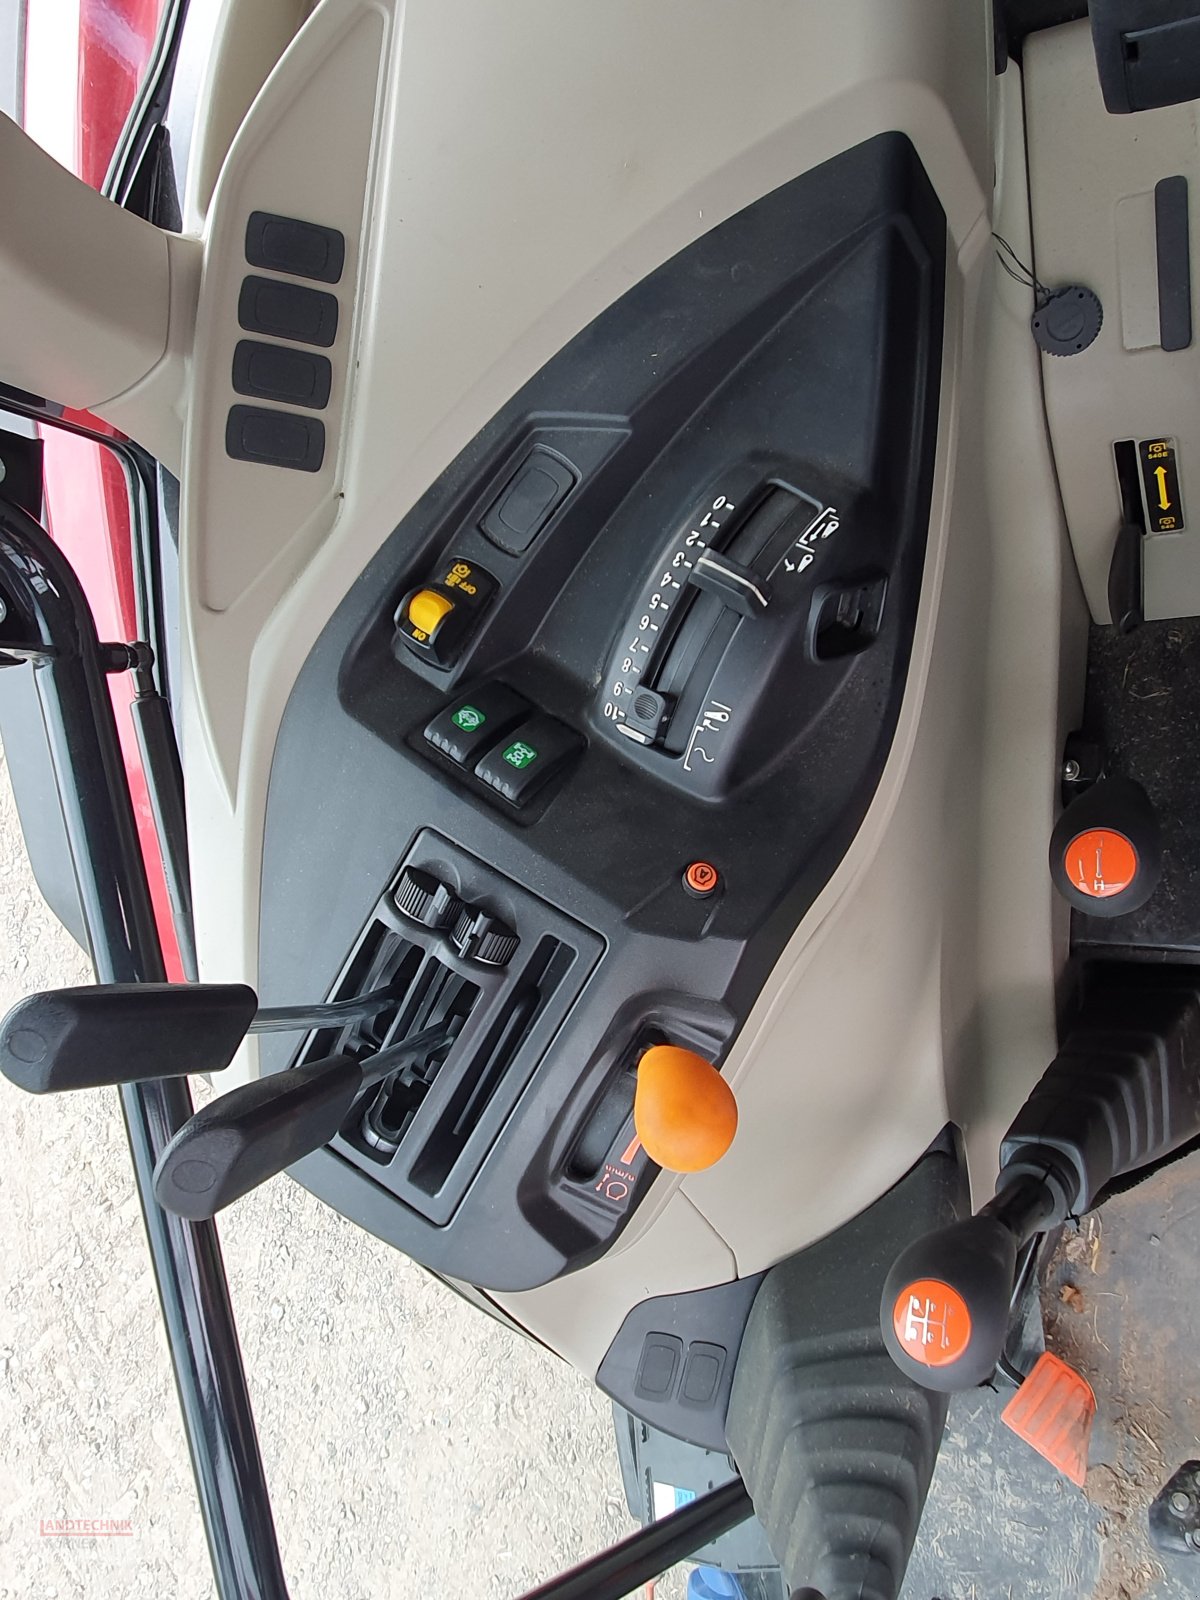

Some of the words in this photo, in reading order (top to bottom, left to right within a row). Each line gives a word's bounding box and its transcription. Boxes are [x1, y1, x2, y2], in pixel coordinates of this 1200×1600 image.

[712, 495, 727, 510] 0
[700, 512, 713, 528] 1
[685, 530, 700, 547] 2
[672, 551, 685, 568] 3
[660, 571, 673, 588] 4
[648, 593, 662, 611] 5
[638, 615, 651, 631] 6
[628, 636, 641, 653] 7
[621, 657, 633, 674] 8
[613, 681, 624, 697] 9
